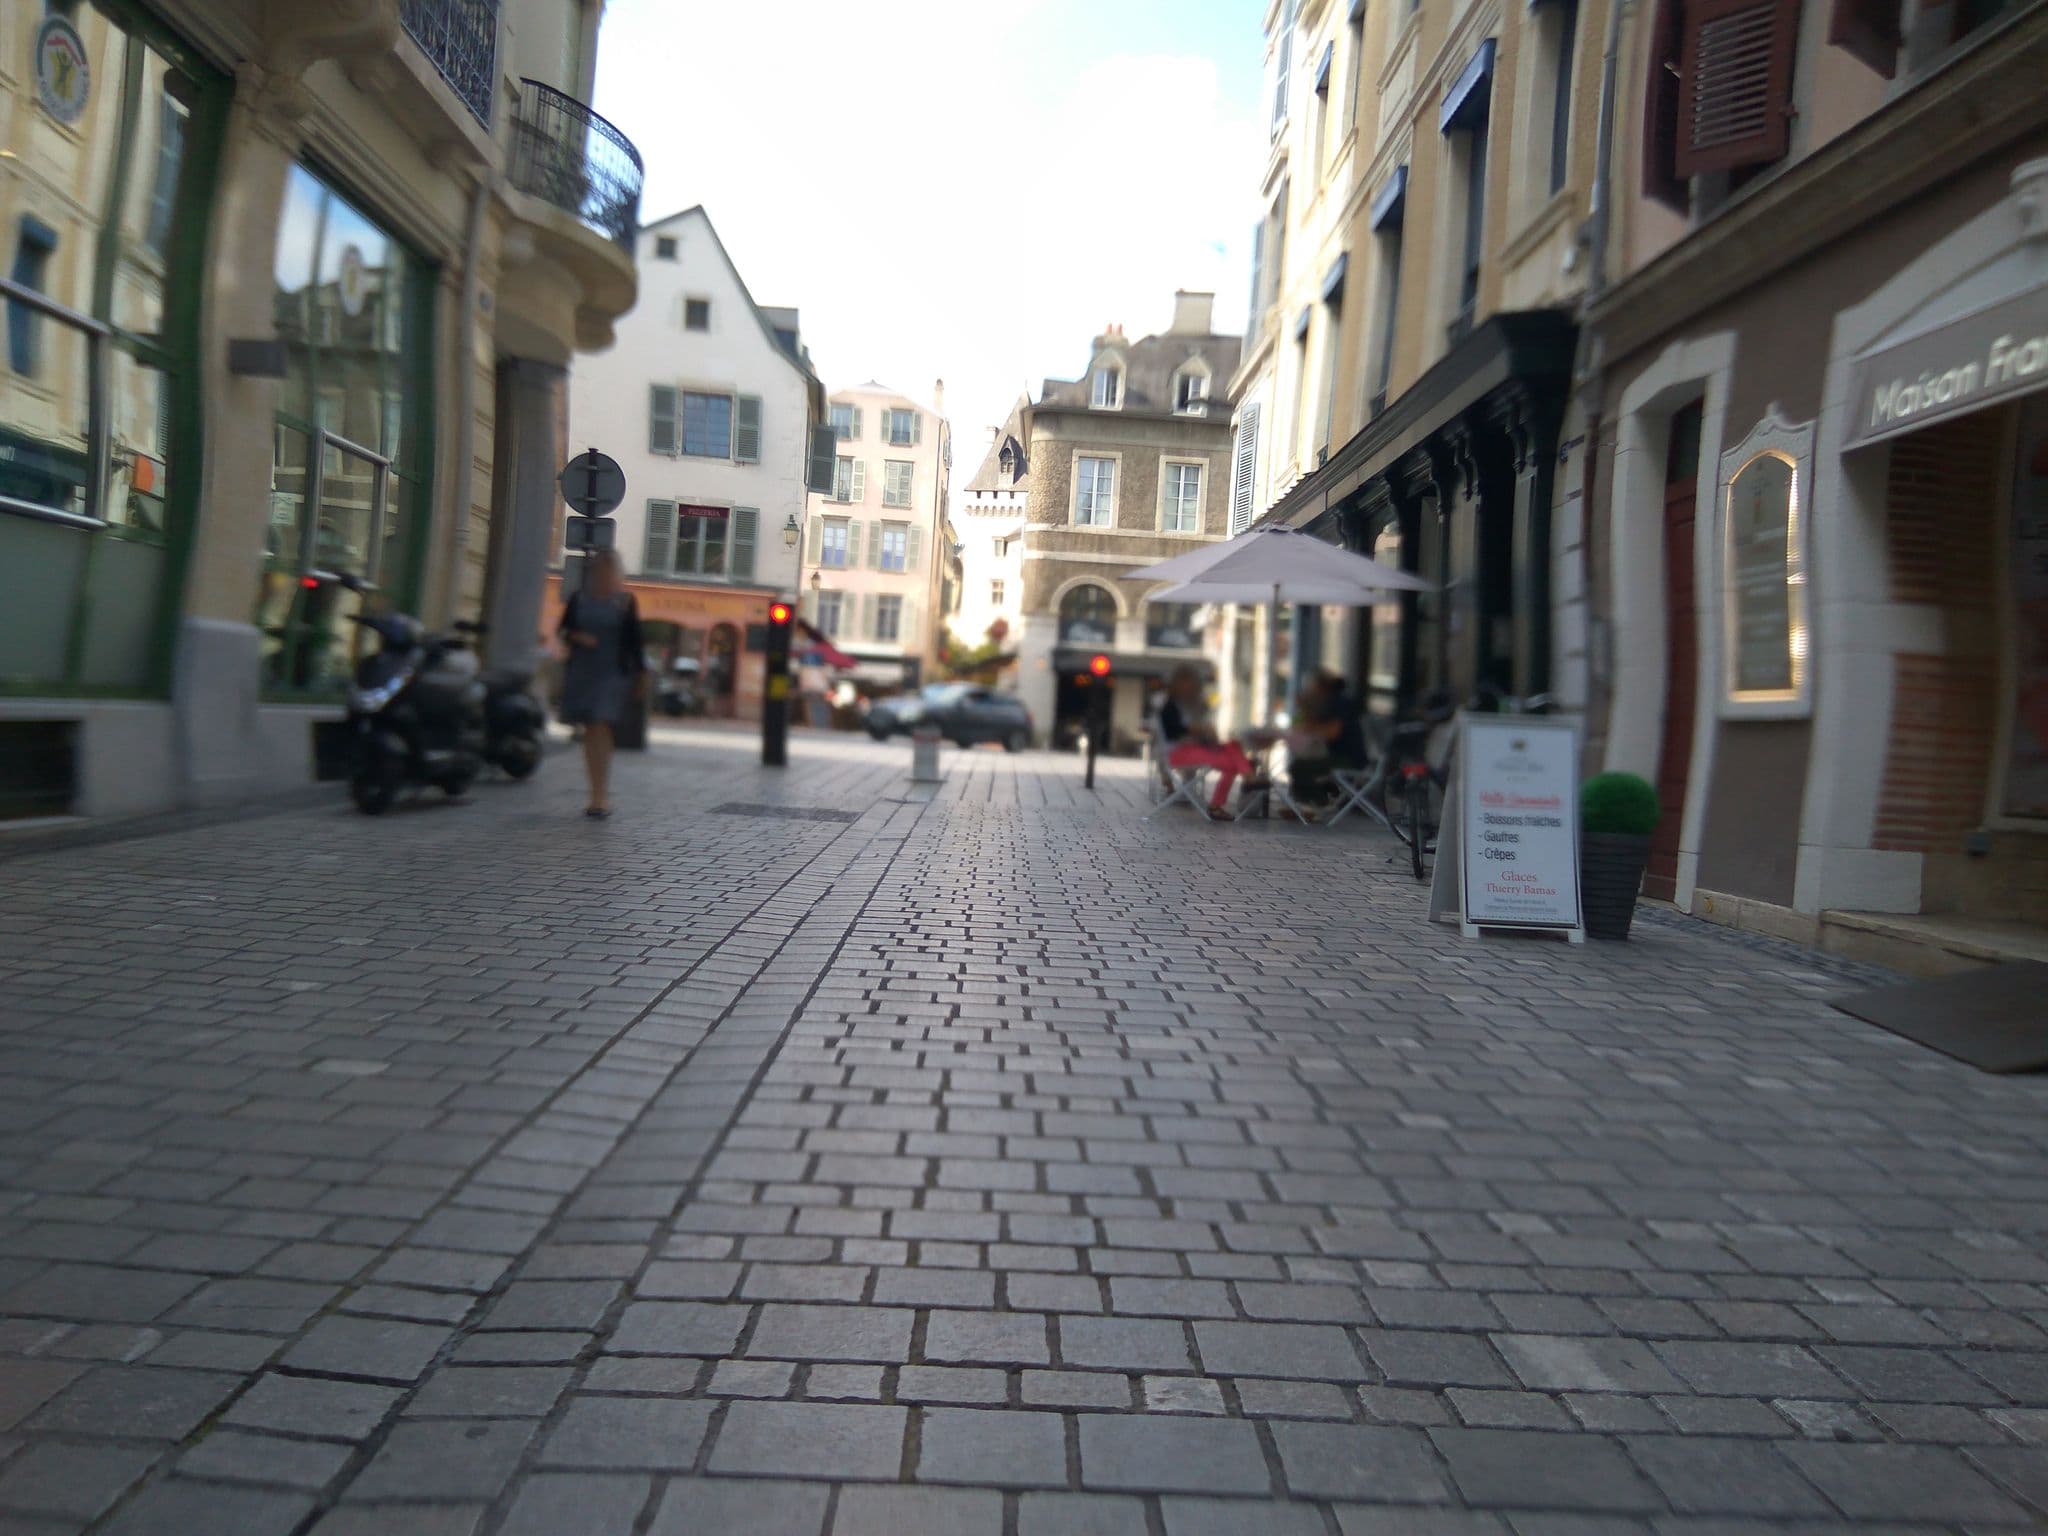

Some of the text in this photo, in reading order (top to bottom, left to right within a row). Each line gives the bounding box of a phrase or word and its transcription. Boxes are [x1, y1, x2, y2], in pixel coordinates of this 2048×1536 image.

[1871, 361, 1979, 427] Maison
[1484, 812, 1523, 826] Boissons
[1484, 830, 1520, 843] Gaufres
[1484, 847, 1516, 861] Crêpes
[1501, 870, 1537, 882] Glaces
[1487, 882, 1557, 896] Thierry Bamas
